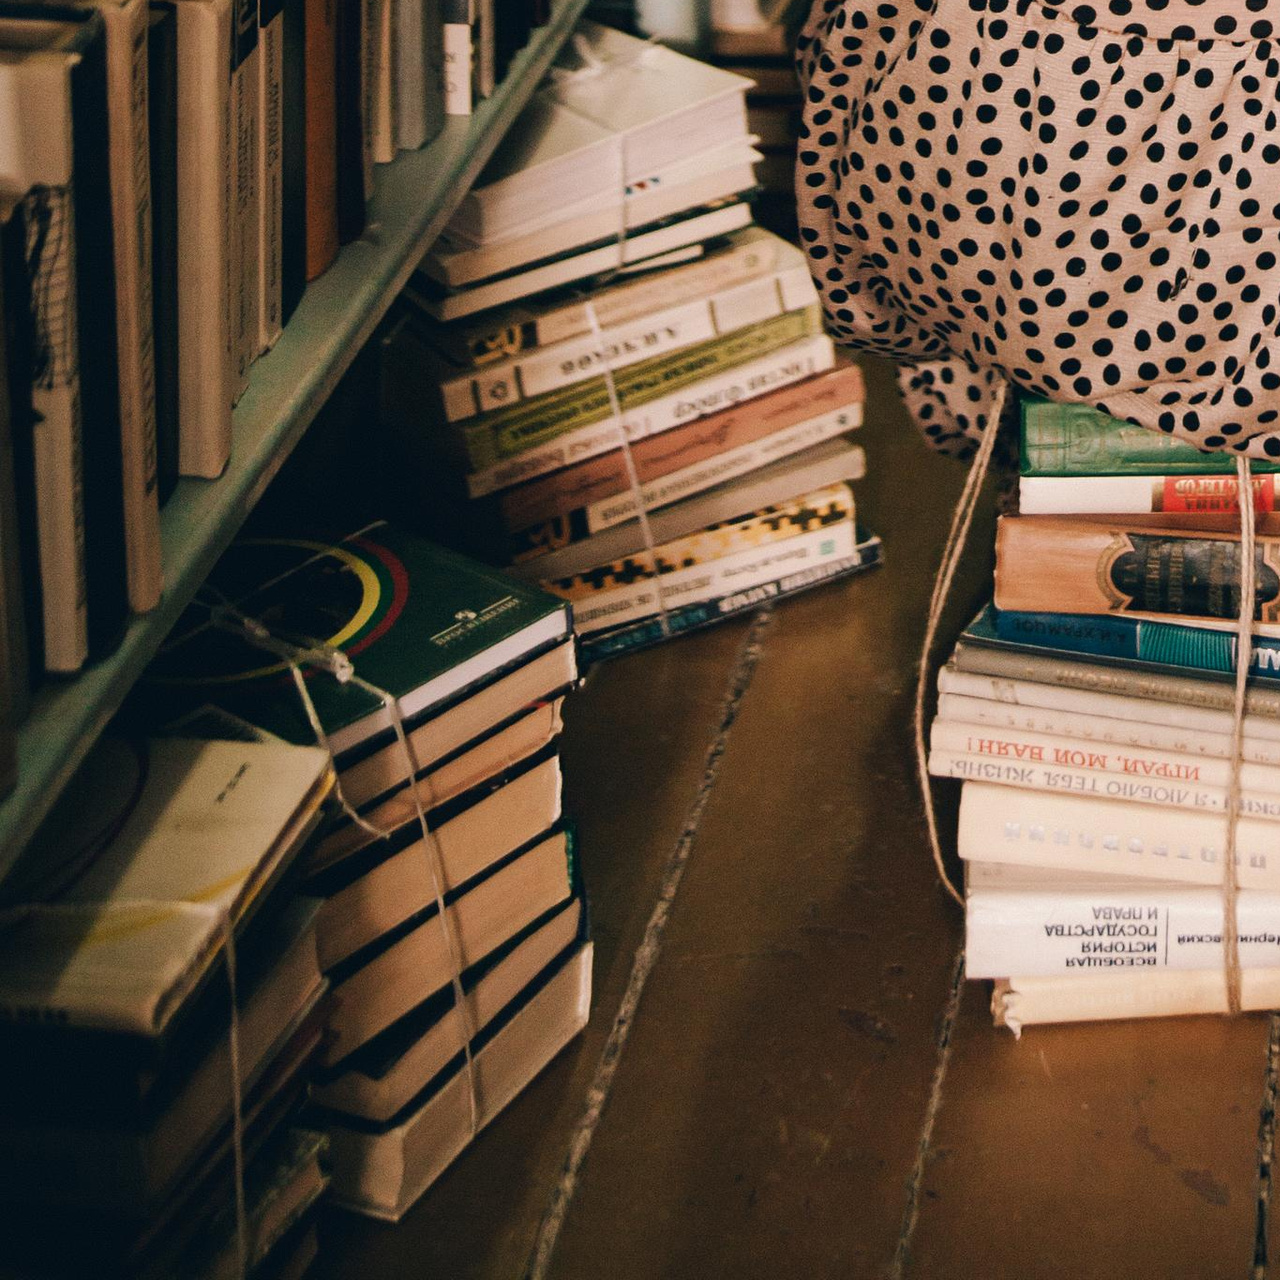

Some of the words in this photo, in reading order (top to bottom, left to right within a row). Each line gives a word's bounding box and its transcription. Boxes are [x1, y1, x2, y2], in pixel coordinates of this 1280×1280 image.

[1174, 478, 1266, 495] МСТЕРОВ
[946, 757, 1034, 785] ЖИЗНЬ!
[1114, 754, 1200, 781] ИГРАЙ,
[1105, 779, 1189, 805] ЛЮБЛЮ
[1193, 792, 1209, 807] Я
[1091, 906, 1141, 920] ПРАВА
[1147, 907, 1157, 920] И
[1044, 923, 1157, 936] ГОСУДАРСТВА
[1081, 940, 1157, 952] ИСТОРИЯ
[1065, 954, 1156, 967] ВСЕОБЩАЯ
